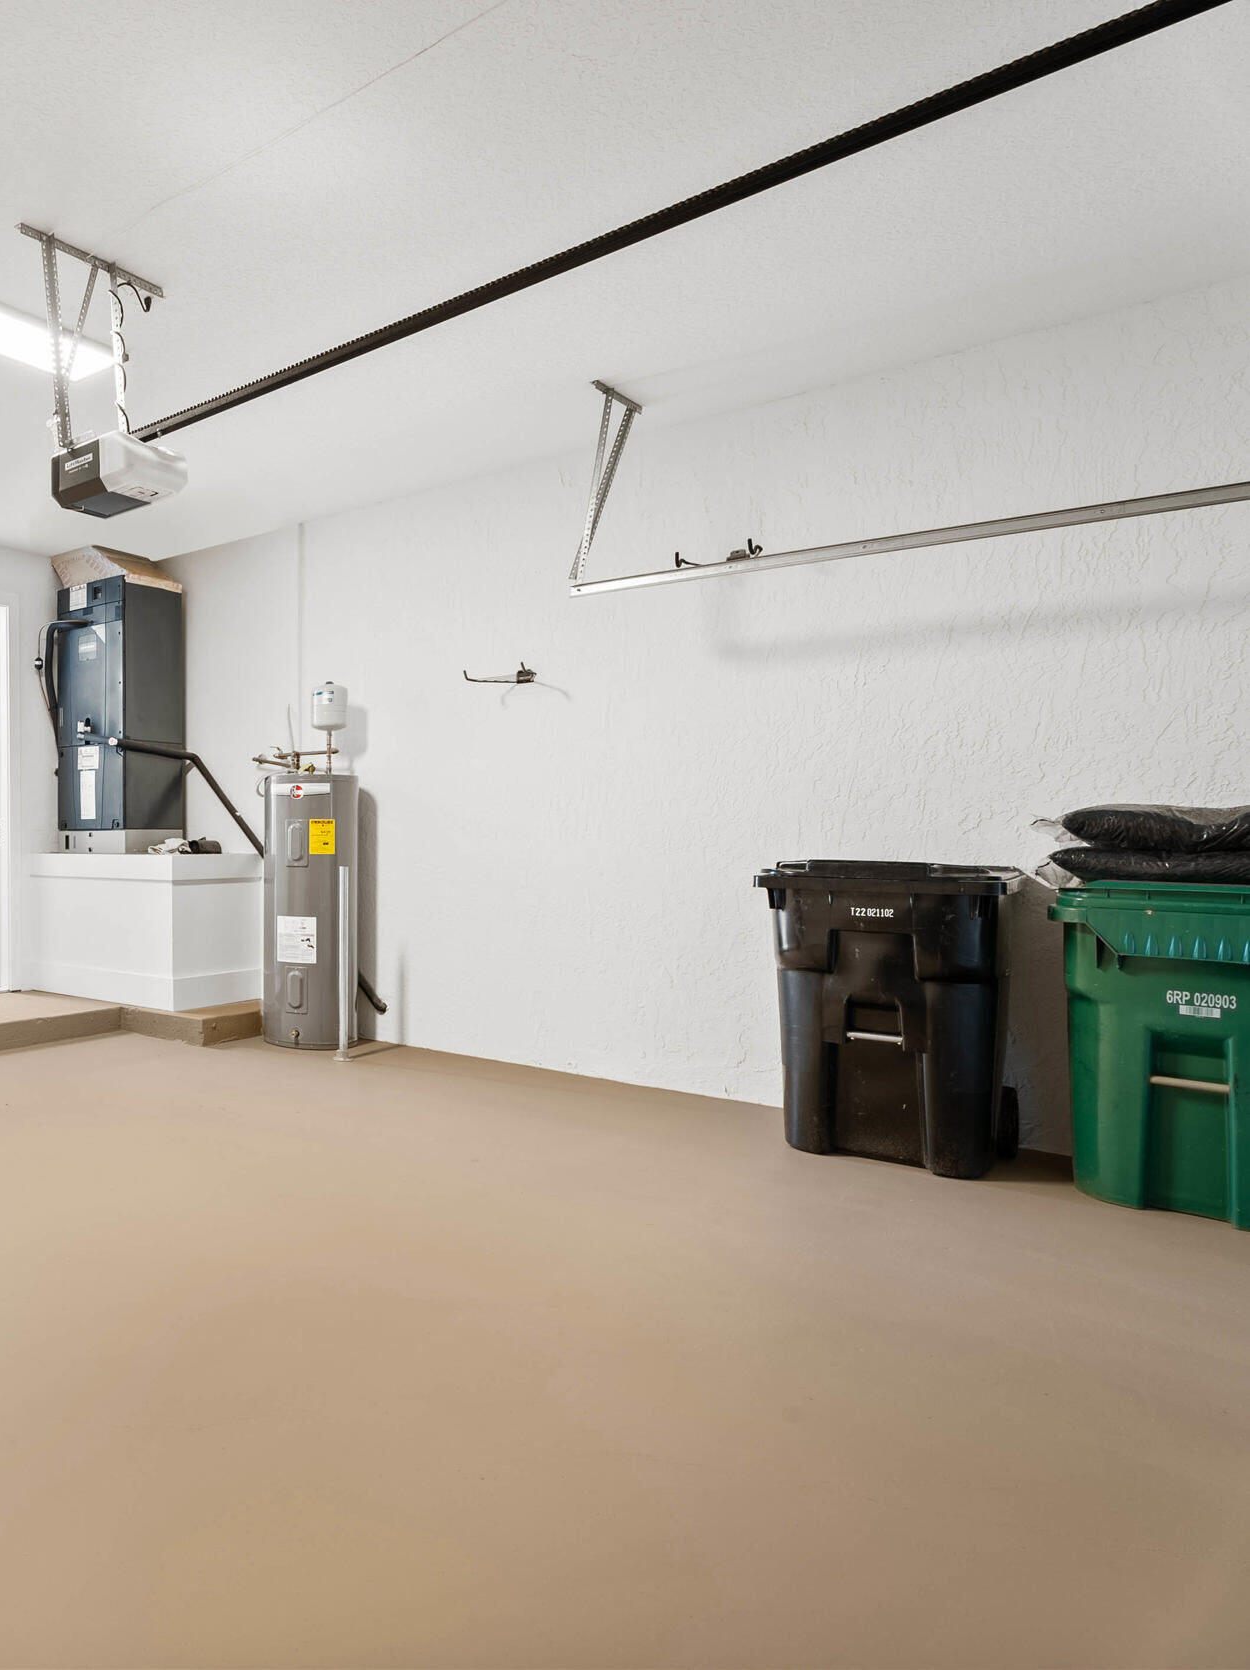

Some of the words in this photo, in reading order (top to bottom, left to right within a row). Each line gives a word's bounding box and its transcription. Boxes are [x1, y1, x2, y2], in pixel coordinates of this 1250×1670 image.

[867, 908, 894, 918] 021102
[1166, 990, 1190, 1004] 6RP
[1193, 992, 1237, 1009] 020903
